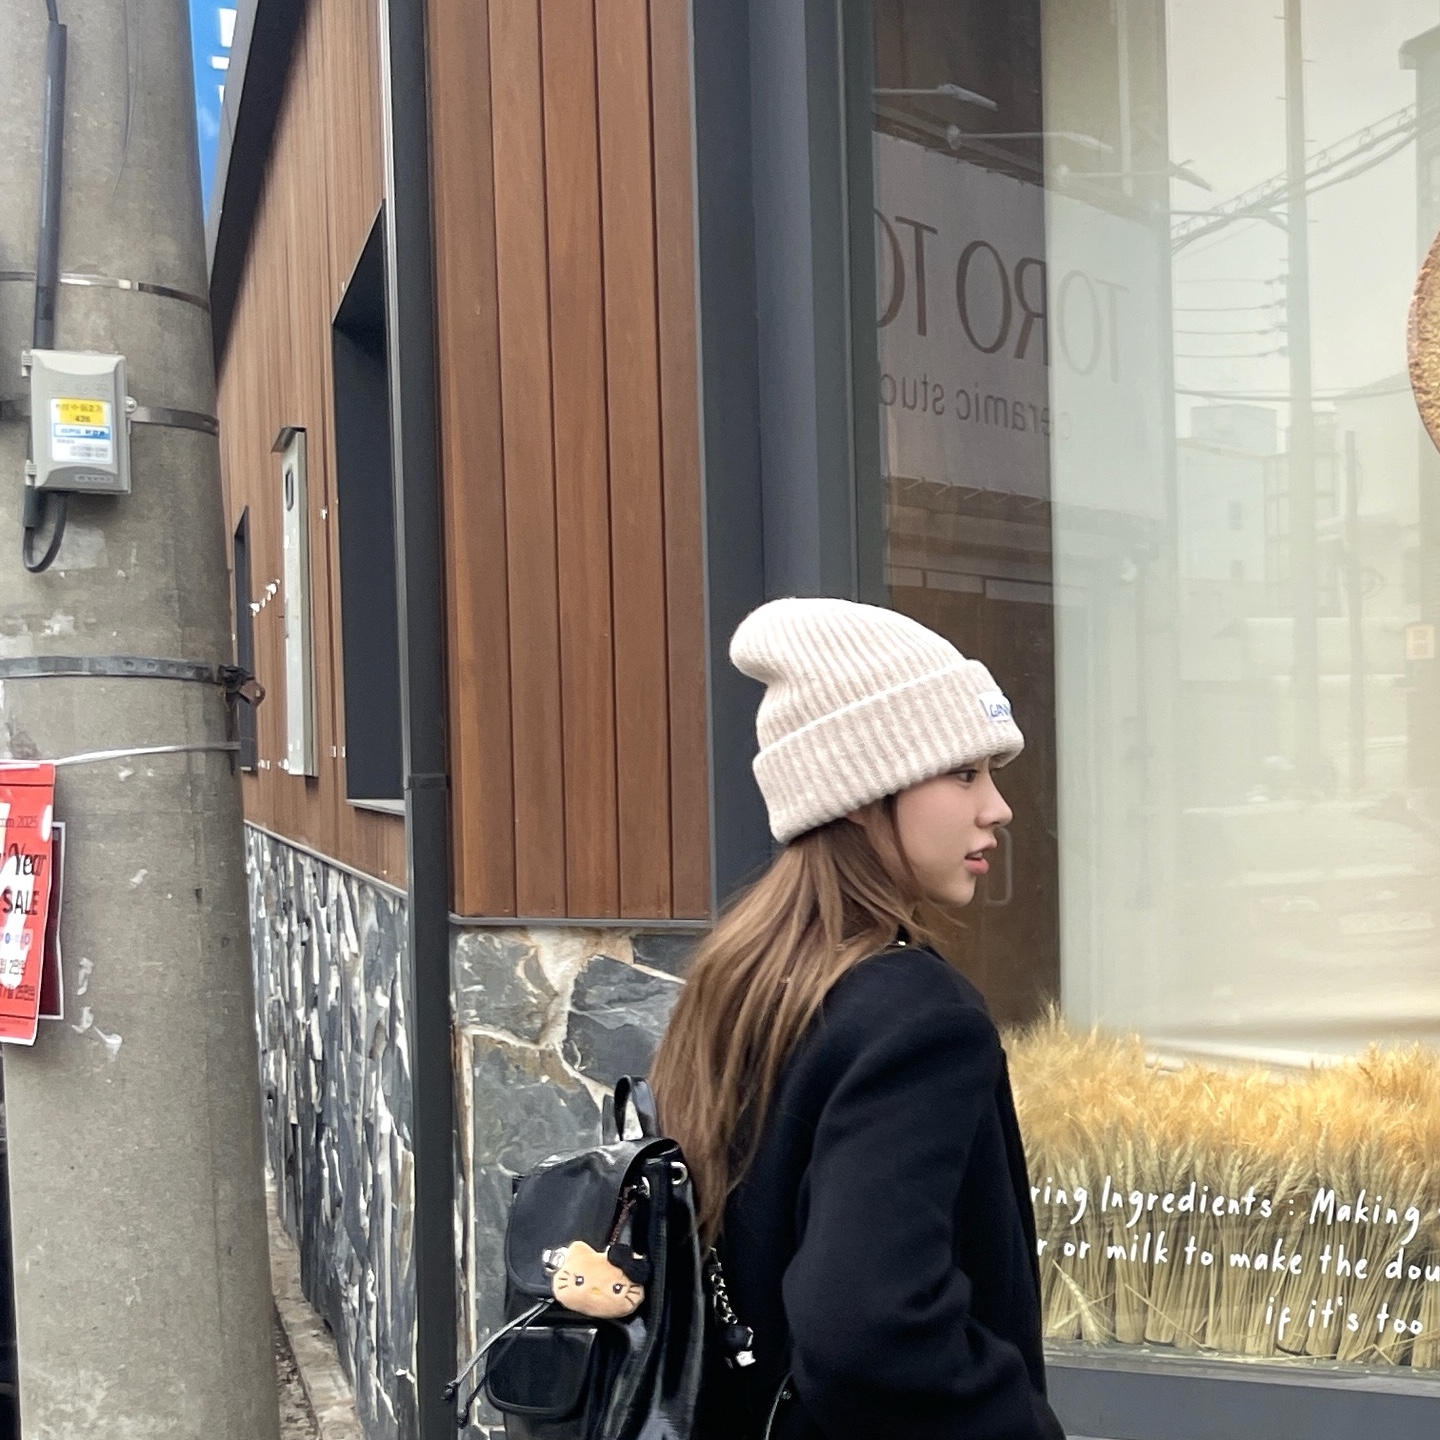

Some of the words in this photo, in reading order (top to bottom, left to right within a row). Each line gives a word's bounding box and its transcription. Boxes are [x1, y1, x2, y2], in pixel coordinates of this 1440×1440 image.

[2, 886, 39, 915] SALE
[1030, 1176, 1088, 1225] ring
[1309, 1187, 1420, 1246] Making
[1063, 1241, 1091, 1259] or
[1106, 1234, 1168, 1265] milk
[1184, 1235, 1214, 1266] to
[1229, 1238, 1302, 1275] make
[1319, 1244, 1368, 1279] the
[1265, 1296, 1291, 1341] if
[1308, 1296, 1359, 1332] it's
[1376, 1302, 1424, 1335] too
